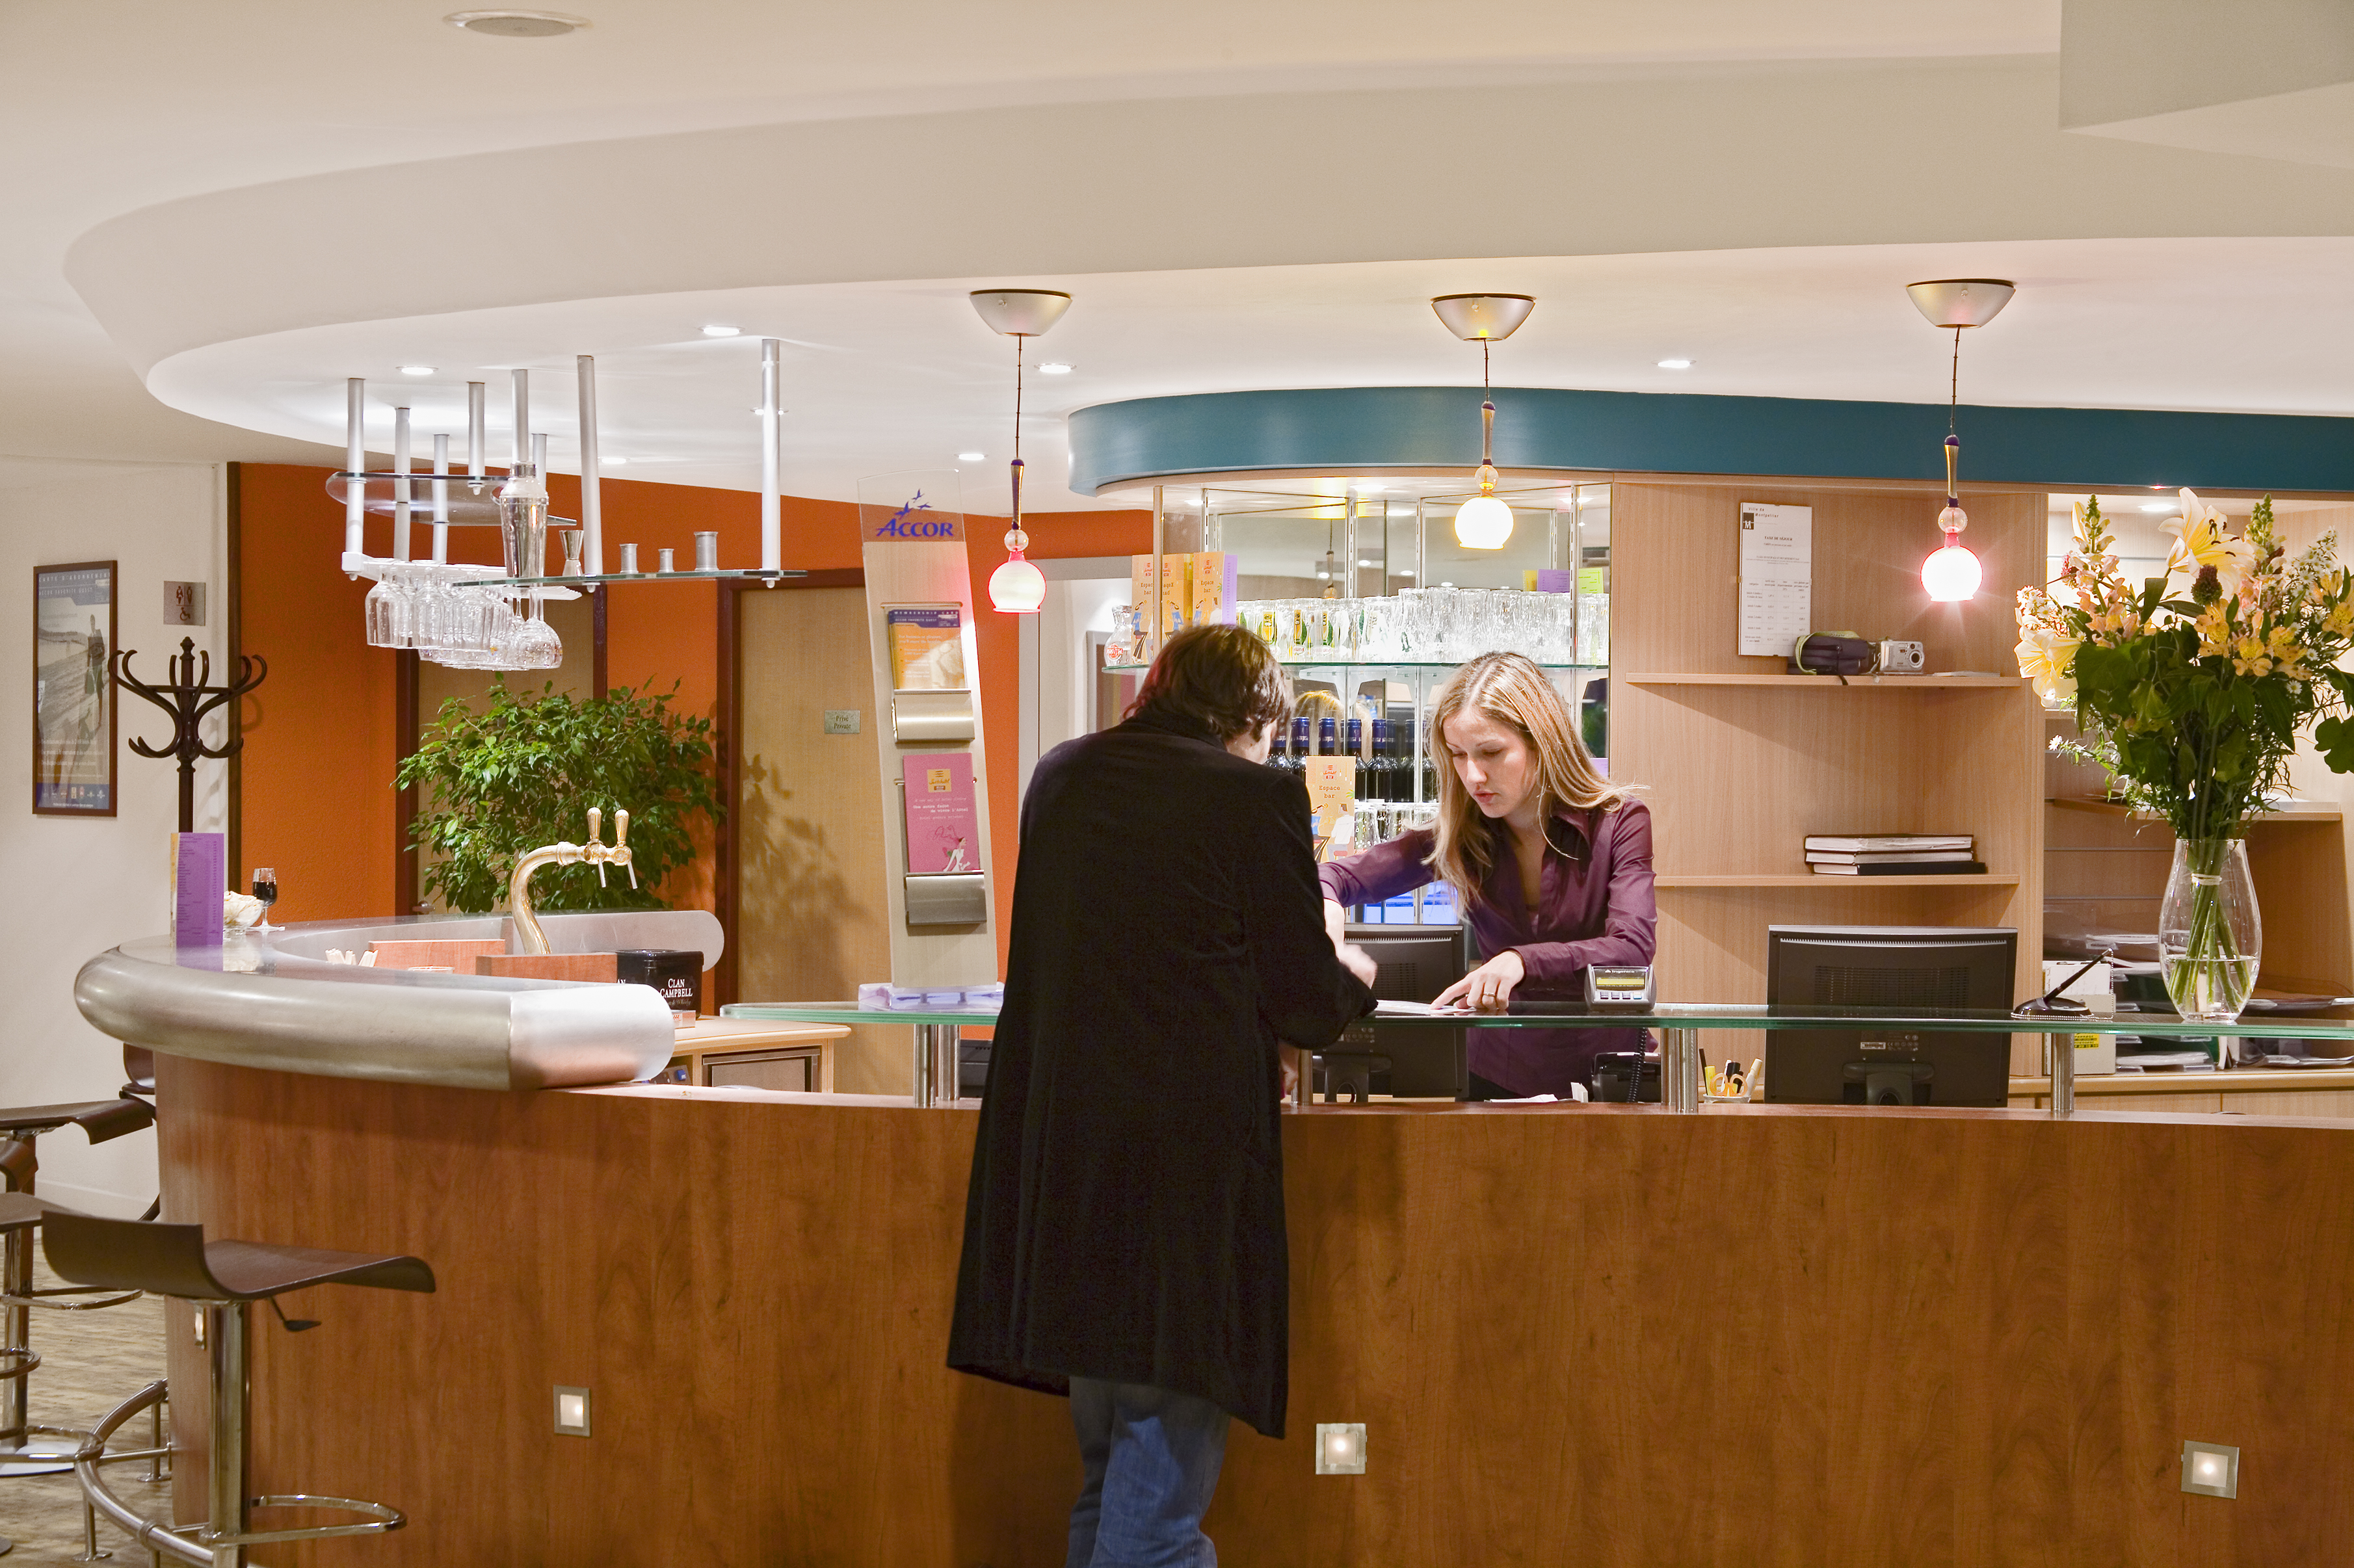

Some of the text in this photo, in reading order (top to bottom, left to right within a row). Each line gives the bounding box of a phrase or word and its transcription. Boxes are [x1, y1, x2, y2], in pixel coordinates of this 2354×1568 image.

[875, 518, 954, 537] ACCOR
[668, 978, 685, 988] CLAN
[659, 988, 693, 998] CAMPBELL
